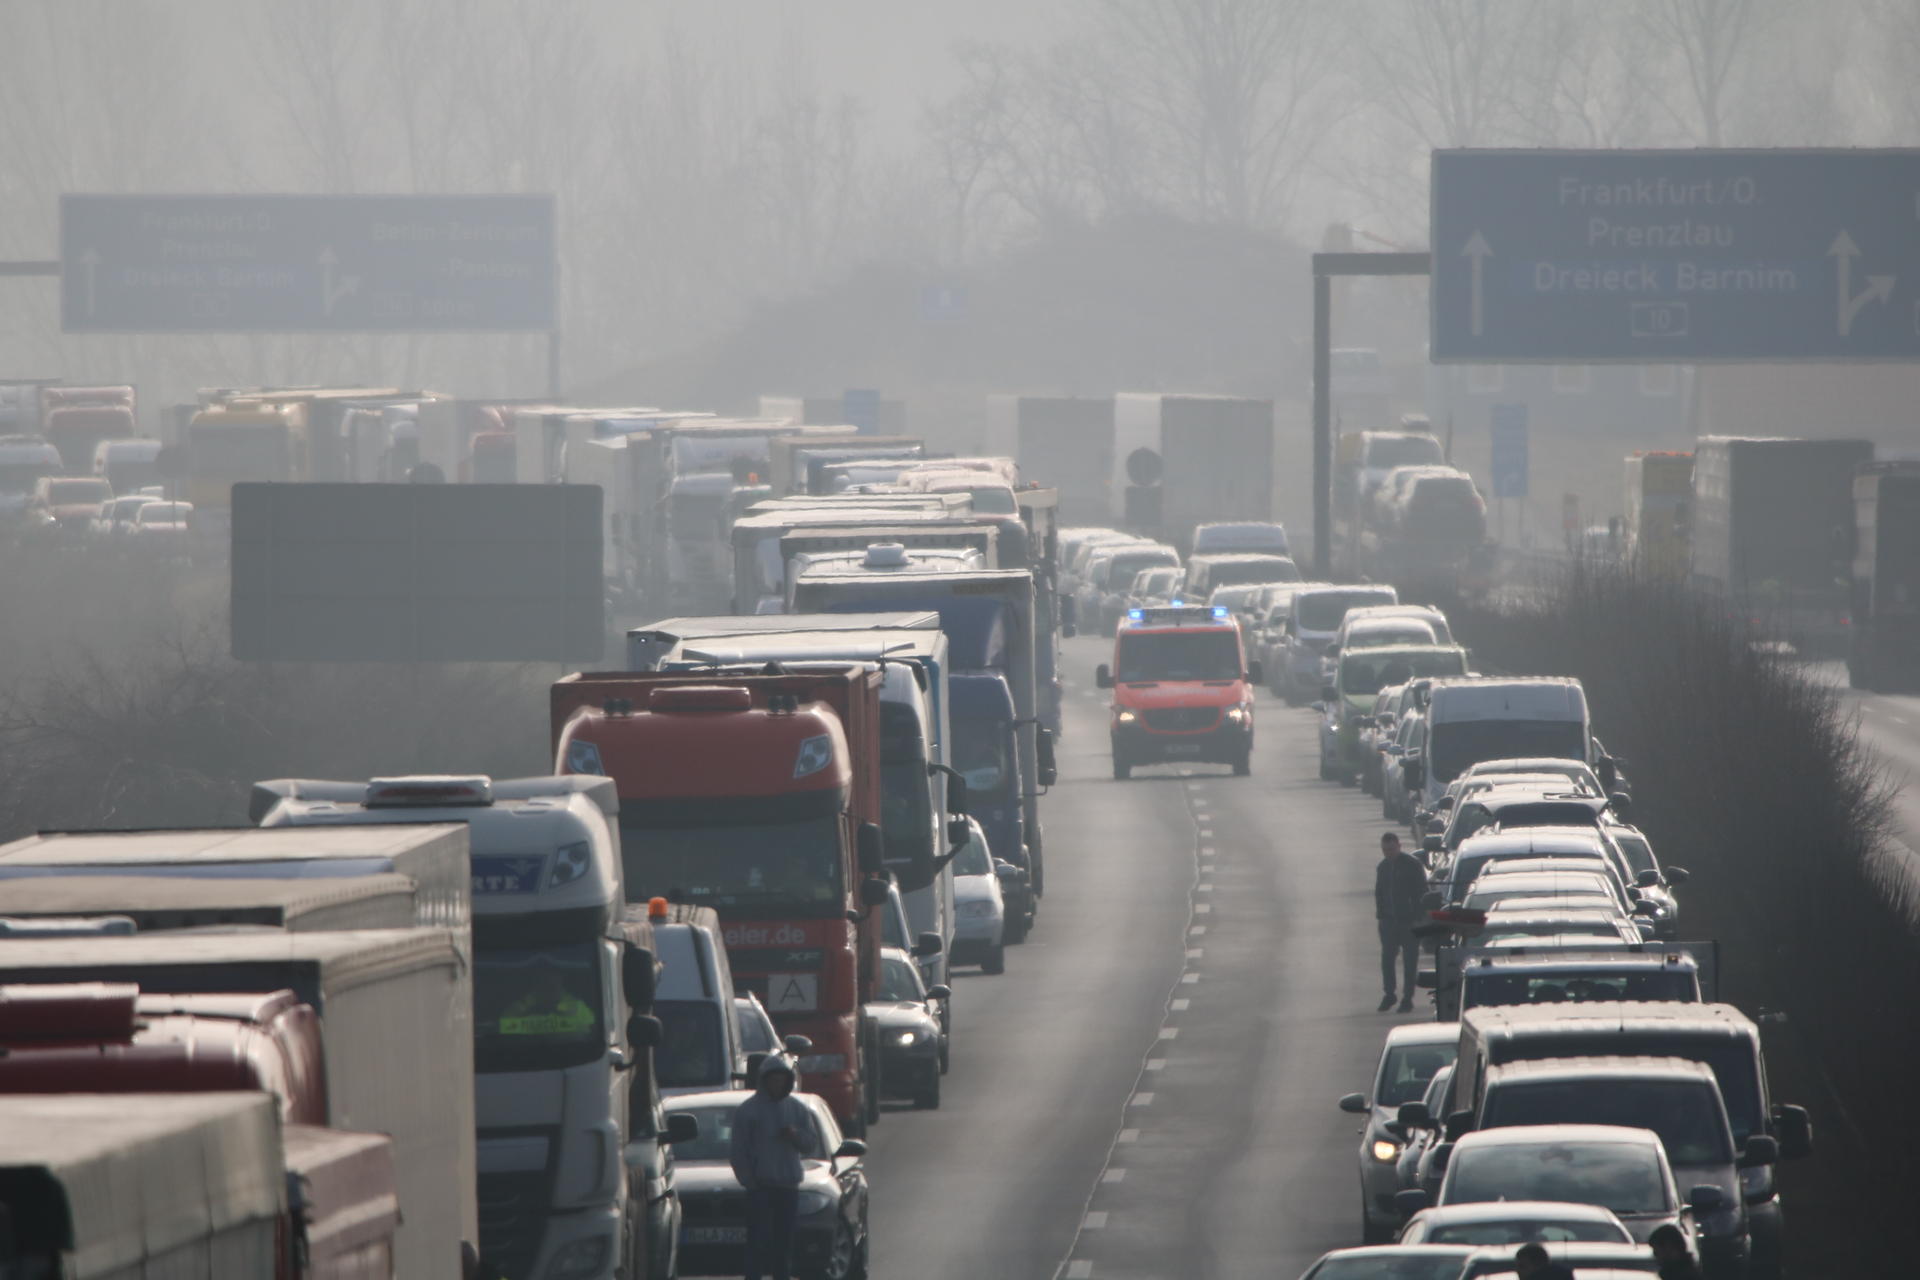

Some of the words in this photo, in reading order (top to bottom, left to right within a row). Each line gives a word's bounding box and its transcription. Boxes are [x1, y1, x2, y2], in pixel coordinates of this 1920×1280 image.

[1559, 176, 1765, 206] Frankfurt/O.
[1587, 216, 1735, 247] Prenzlau
[1532, 261, 1660, 290] Dreieck
[1675, 261, 1798, 290] Barnim
[1648, 309, 1673, 330] 10
[779, 978, 807, 1004] A
